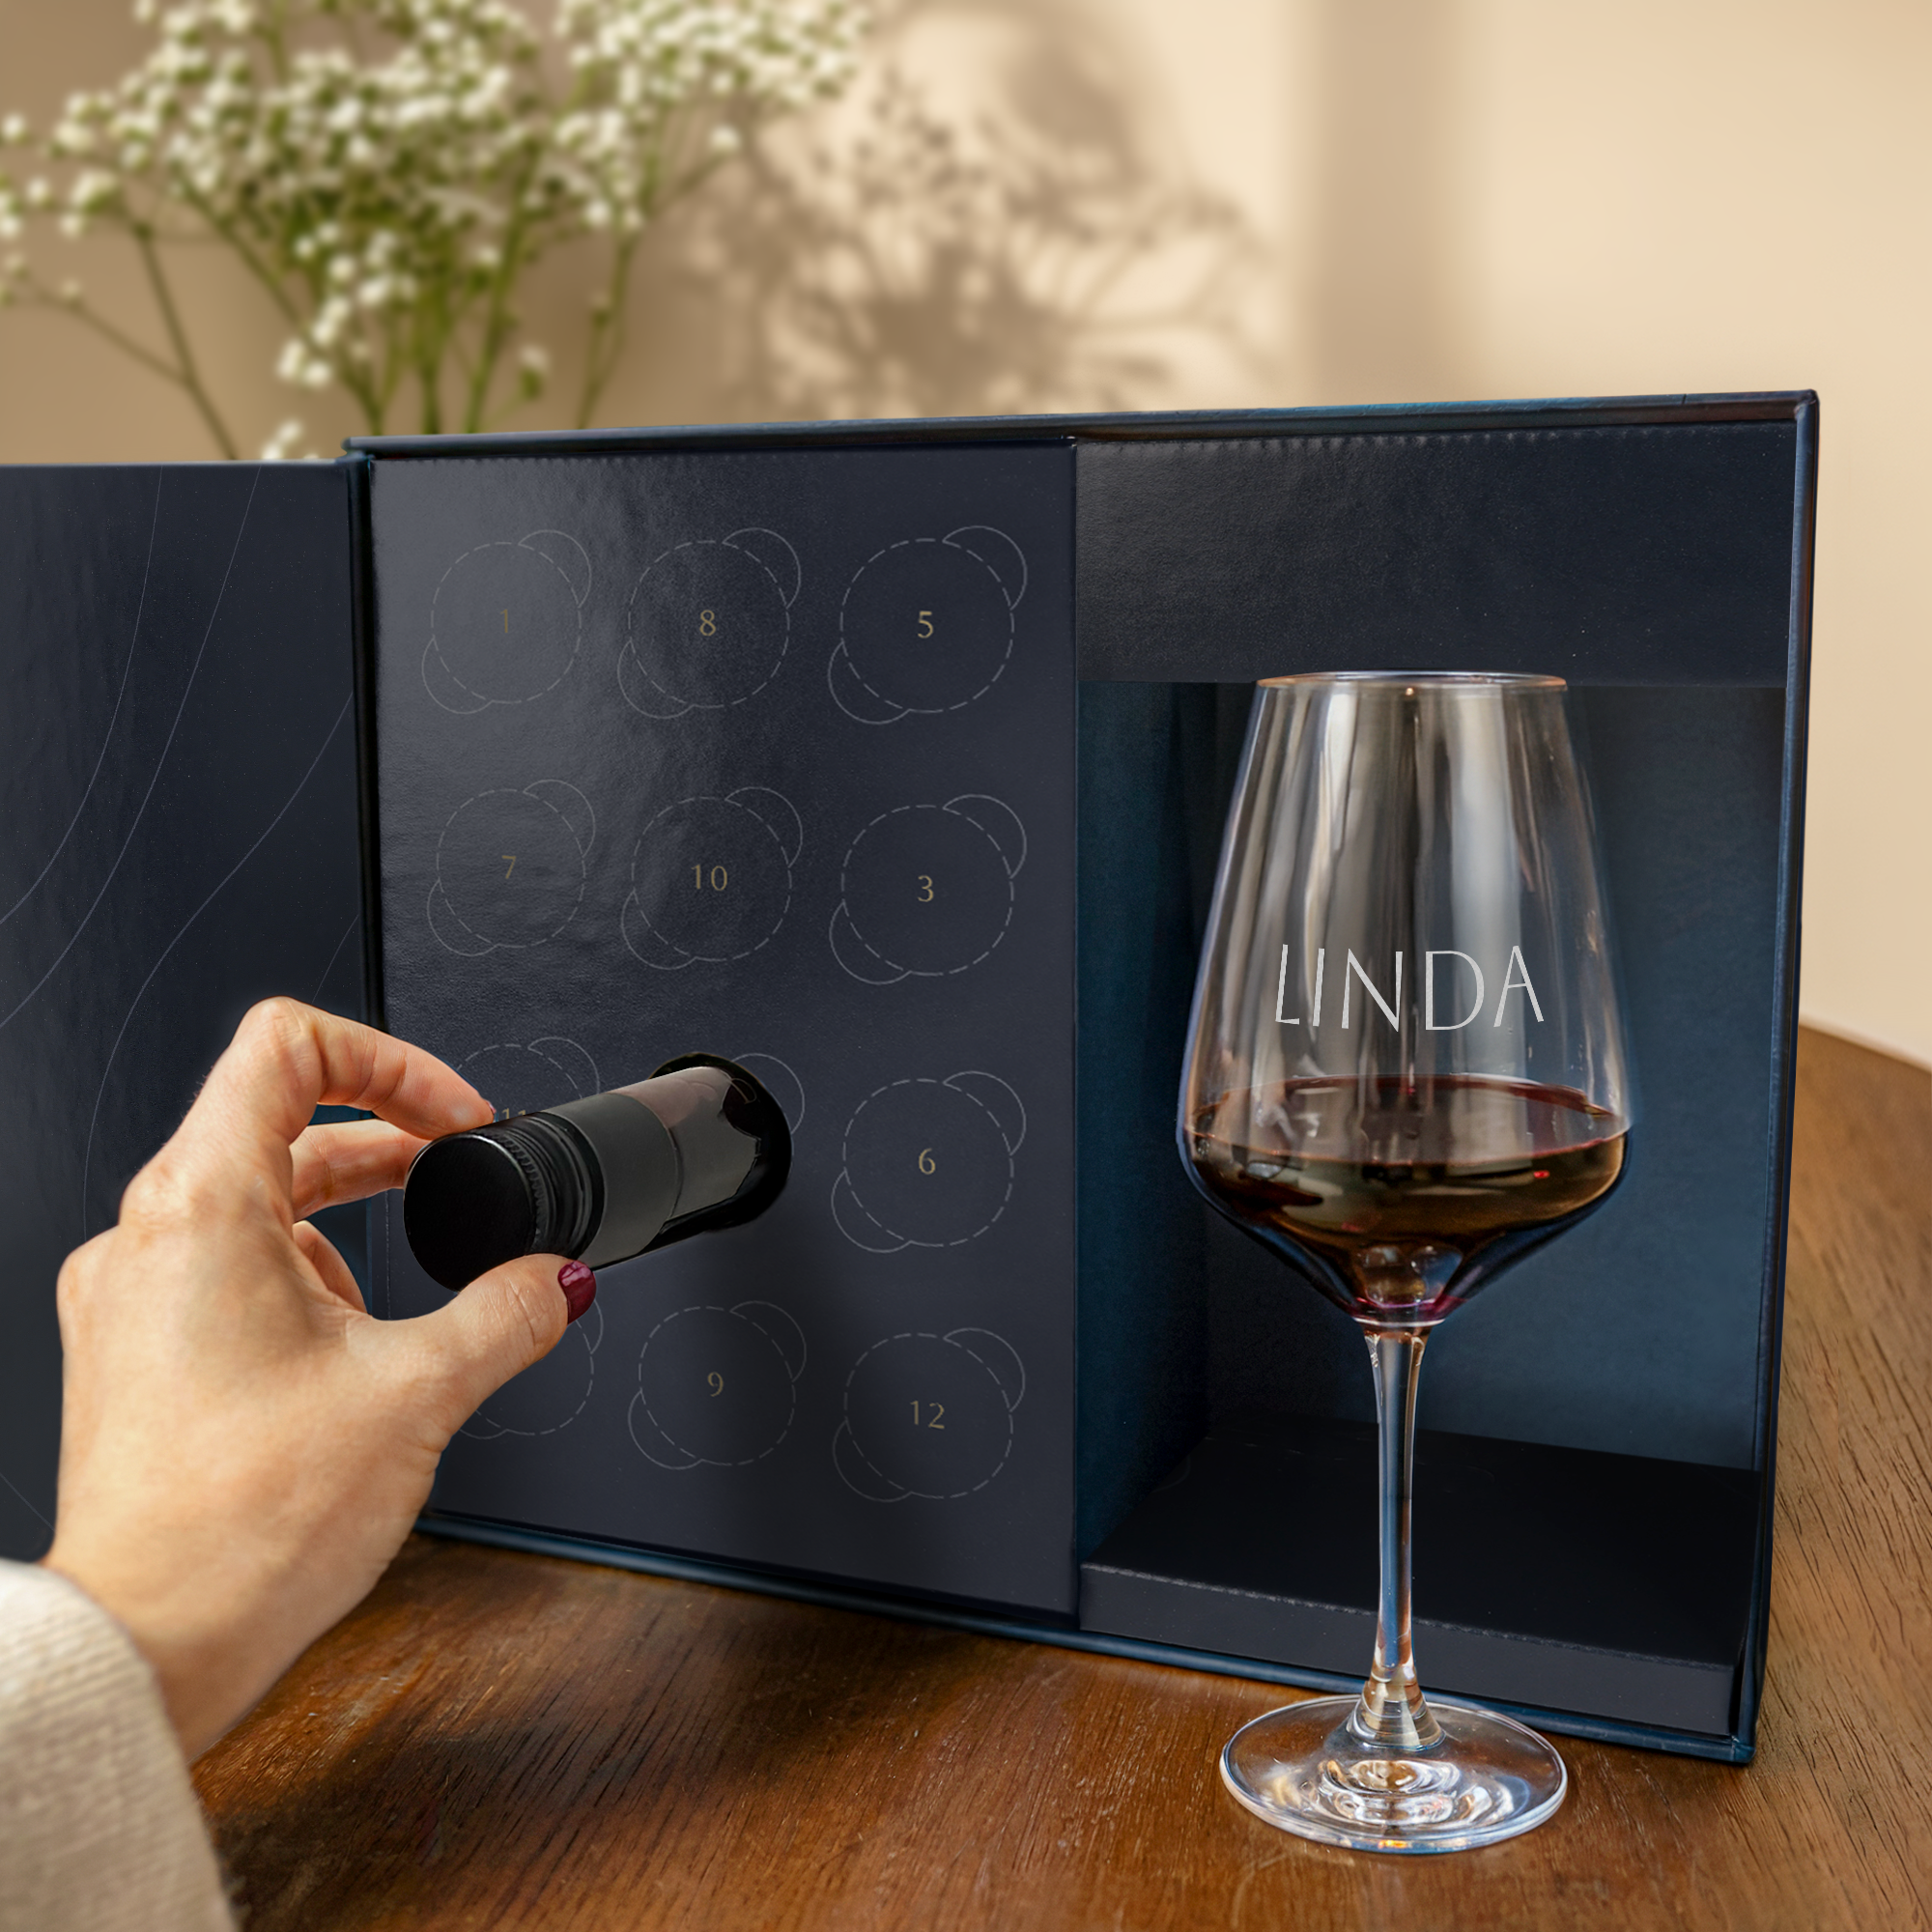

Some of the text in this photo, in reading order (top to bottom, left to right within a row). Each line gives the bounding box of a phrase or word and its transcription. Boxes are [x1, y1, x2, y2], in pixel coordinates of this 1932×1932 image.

[500, 608, 509, 634] 1
[698, 610, 717, 637] 8
[917, 610, 934, 639] 5
[501, 854, 517, 879] 7
[691, 864, 728, 892] 10
[918, 875, 934, 902] 3
[1275, 944, 1545, 1032] LINDA
[918, 1148, 936, 1176] 6
[707, 1372, 724, 1397] 9
[910, 1400, 945, 1430] 12
